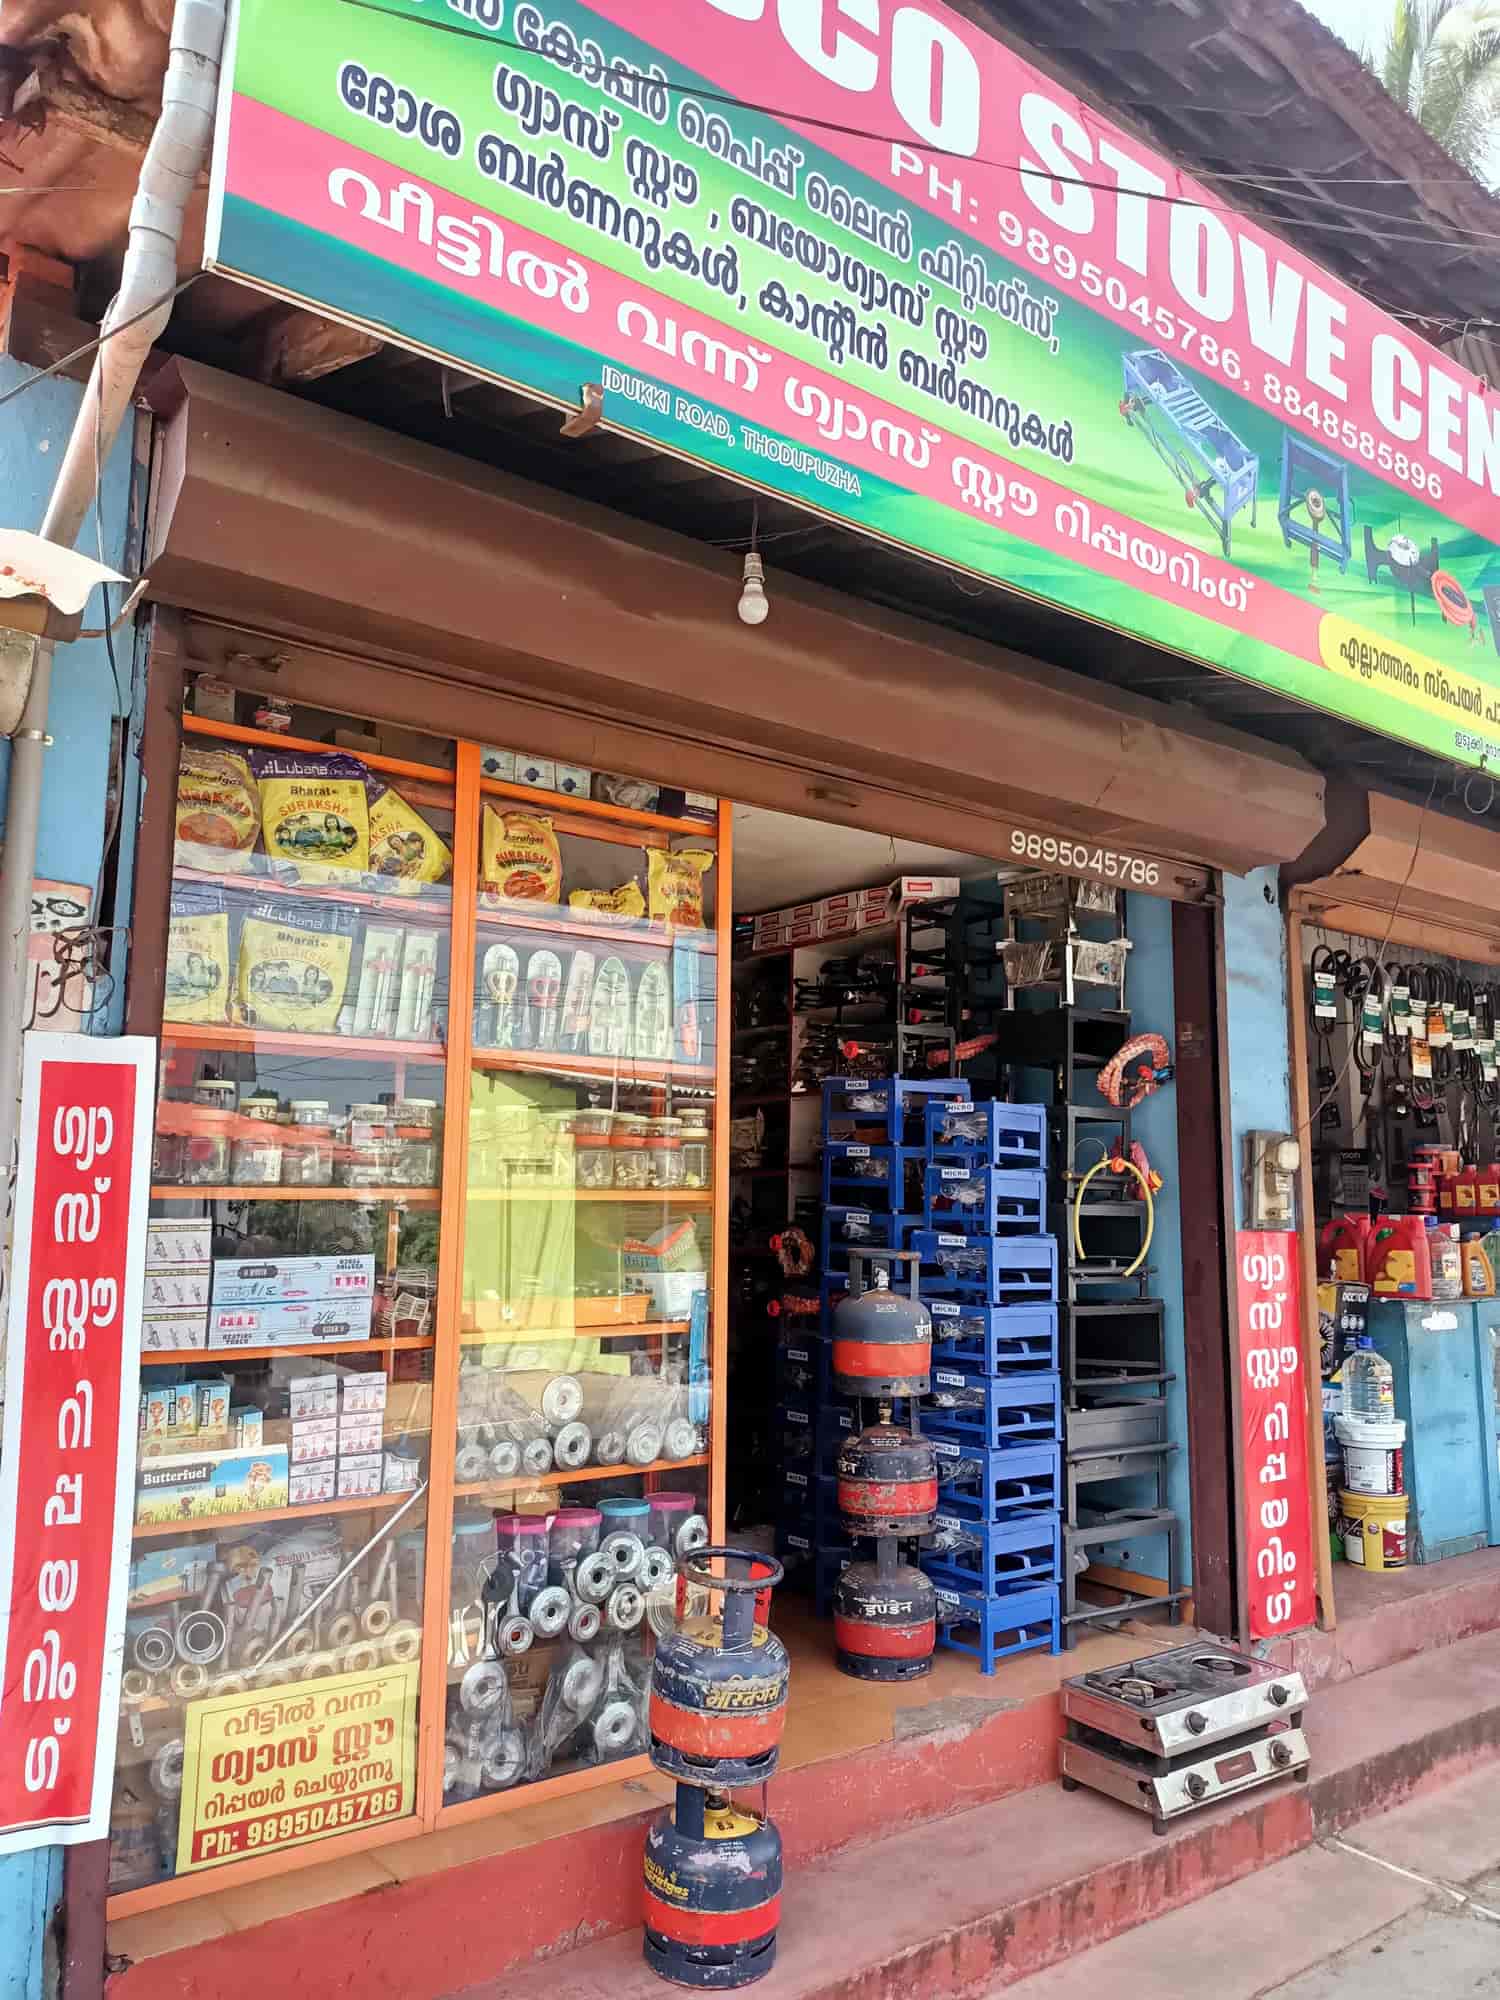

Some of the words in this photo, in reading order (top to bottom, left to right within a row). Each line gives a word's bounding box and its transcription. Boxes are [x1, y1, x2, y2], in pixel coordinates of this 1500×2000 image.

[497, 67, 620, 158] ഗ്യാസ്
[731, 198, 930, 326] ബയോഗ്യാസ്
[705, 0, 980, 157] CO
[1019, 92, 1347, 402] STOVE
[808, 175, 911, 260] ലൈൻ
[341, 65, 461, 155] ദോശ
[899, 349, 1074, 463] ബർണറുകൾ
[890, 143, 979, 224] PH:
[998, 209, 1251, 389] 9895045786,
[1263, 372, 1443, 499] 8848585896
[328, 168, 590, 313] വീട്ടിൽ
[616, 300, 772, 393] വന്ന്
[784, 378, 941, 469] ഗ്യാസ്
[1055, 501, 1255, 613] റിപ്പയറിംഗ്
[602, 365, 670, 415] IDUKKI
[676, 398, 735, 447] ROAD,
[740, 425, 862, 497] THODUPUZHA
[274, 760, 328, 775] Lubana
[1010, 830, 1159, 886] 9895045786
[52, 1104, 114, 1245] ഗ്യാസ്
[1242, 1251, 1287, 1331] ഗ്യാസ്
[224, 1699, 314, 1736] വീട്ടിൽ
[324, 1681, 388, 1717] വന്ന്
[204, 1778, 286, 1821] റിപ്പയർ
[293, 1759, 393, 1798] ചെയ്യുന്നു
[211, 1724, 325, 1785] ഗ്യാസ്
[200, 1829, 241, 1858] Ph:
[247, 1789, 399, 1847] 9895045786
